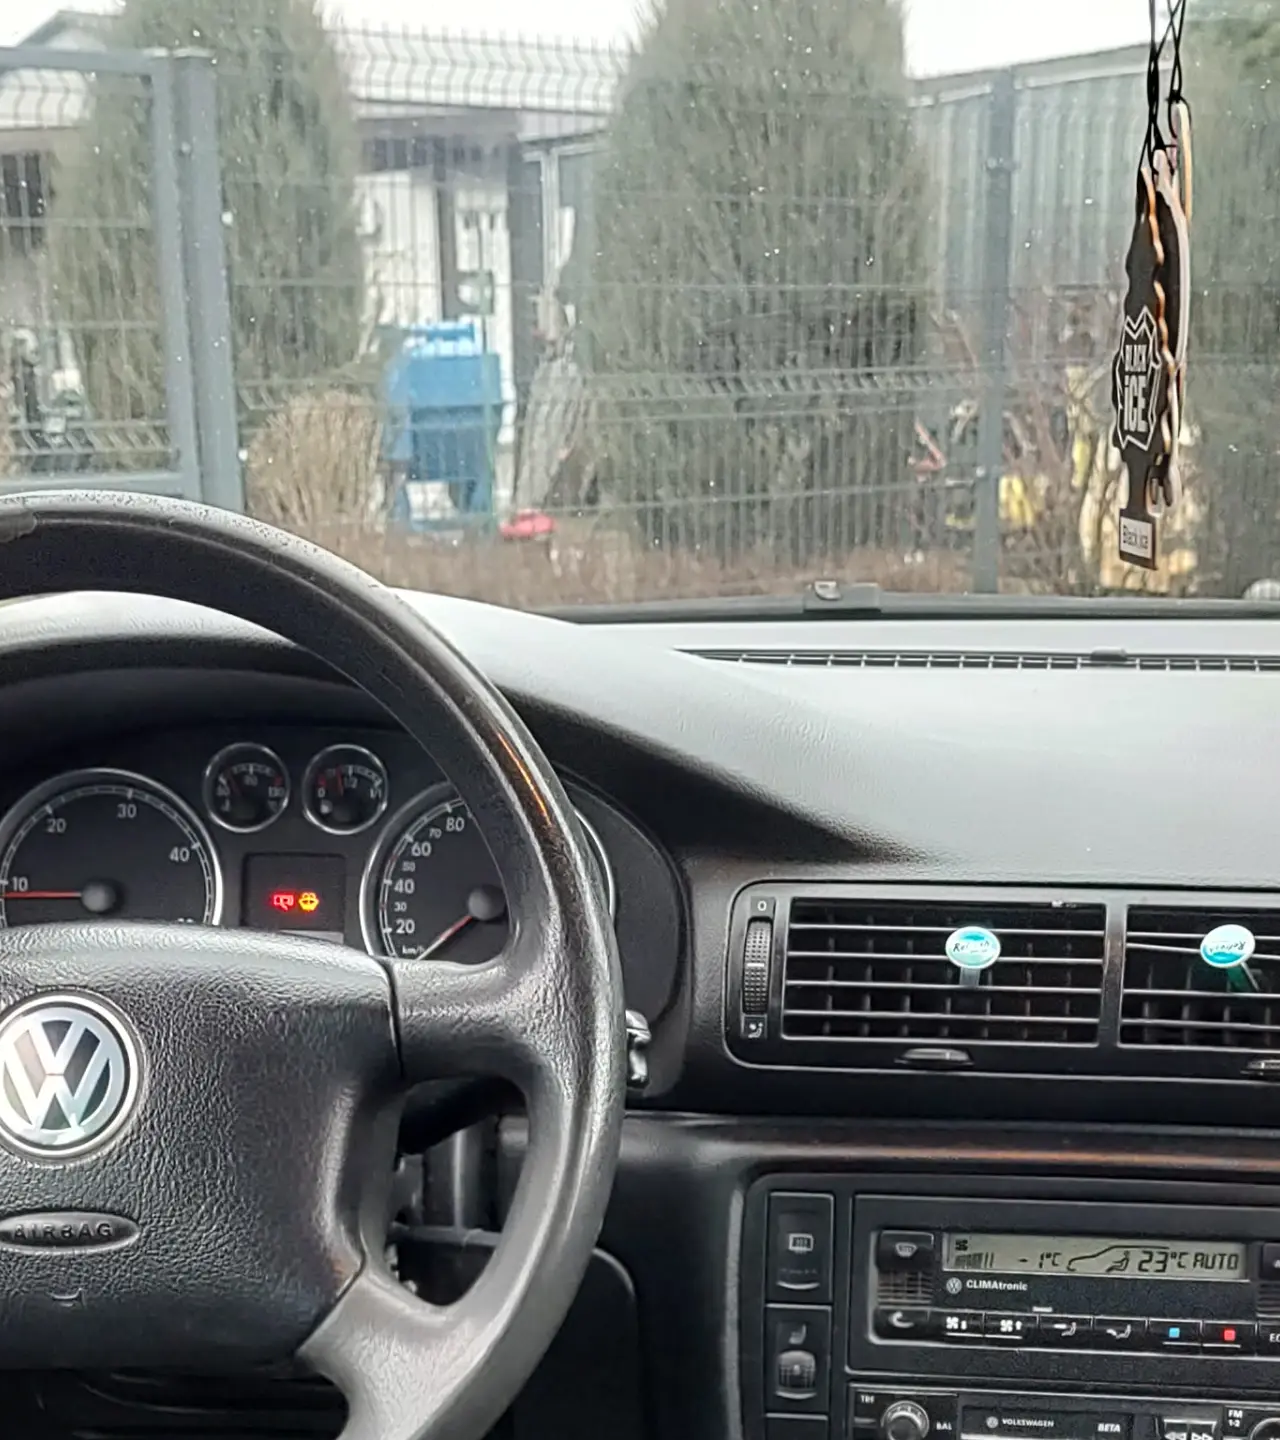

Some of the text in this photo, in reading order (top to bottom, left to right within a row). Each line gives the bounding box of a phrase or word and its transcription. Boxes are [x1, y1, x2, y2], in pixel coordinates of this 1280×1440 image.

[117, 804, 137, 818] 30
[47, 818, 66, 833] 20
[446, 817, 465, 832] 80
[429, 828, 442, 839] 70
[169, 847, 189, 862] 40
[411, 841, 432, 856] 60
[12, 877, 29, 891] 10
[394, 878, 415, 894] 40
[394, 902, 407, 912] 30
[396, 919, 415, 934] 20
[12, 1222, 114, 1241] AIRBAG
[1193, 1252, 1239, 1270] AUTO
[966, 1279, 1028, 1291] CLIMAtronic
[1228, 1410, 1243, 1419] FM
[936, 1422, 952, 1430] BAL
[1002, 1418, 1054, 1427] VOLKSWAGEN
[1098, 1423, 1121, 1432] BETA
[1228, 1419, 1241, 1428] 1-2
